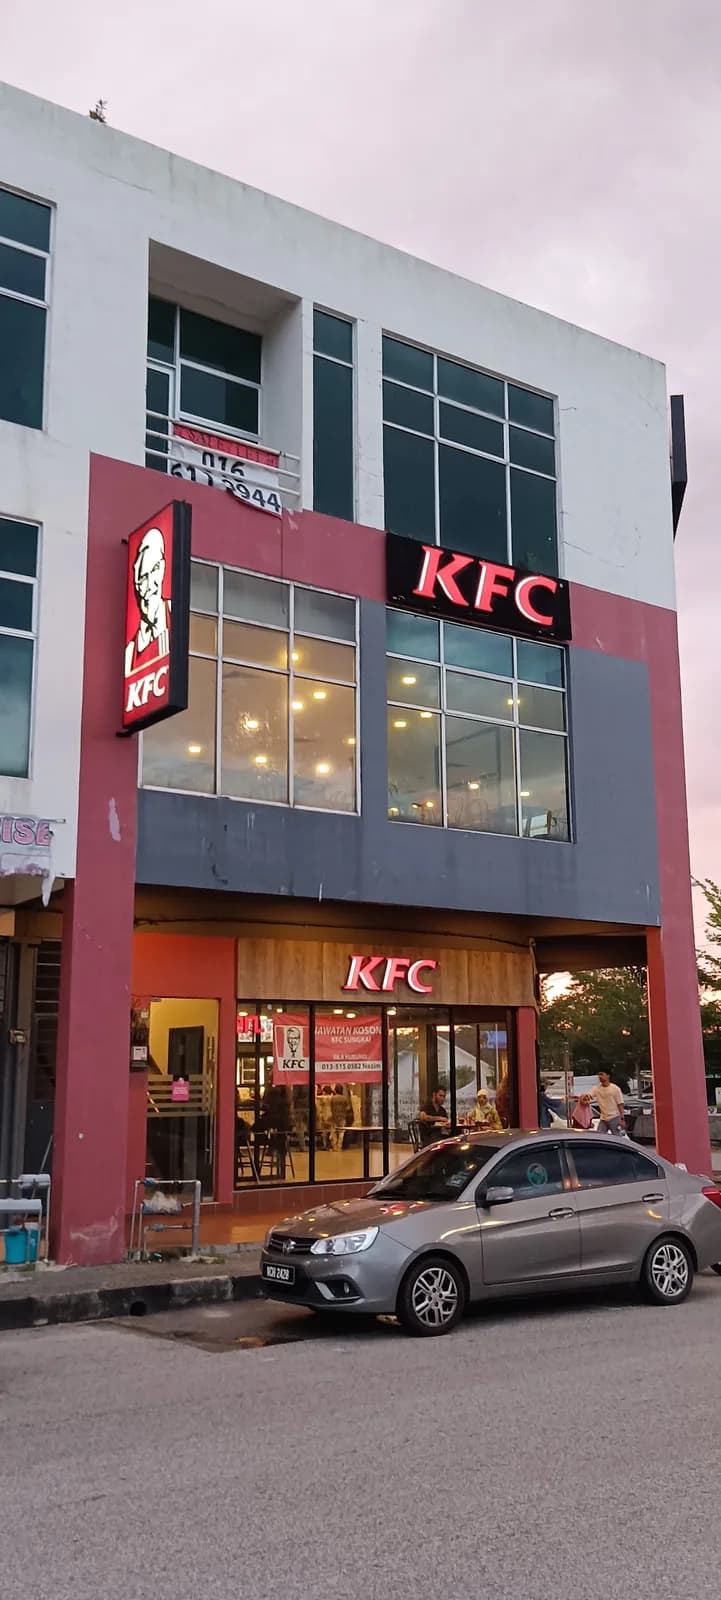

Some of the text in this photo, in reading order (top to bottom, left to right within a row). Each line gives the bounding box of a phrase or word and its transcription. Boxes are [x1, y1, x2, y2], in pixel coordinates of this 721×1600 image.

[412, 545, 558, 627] KFC
[125, 669, 167, 713] KFC
[342, 954, 437, 994] KFC
[282, 1059, 305, 1069] KFC
